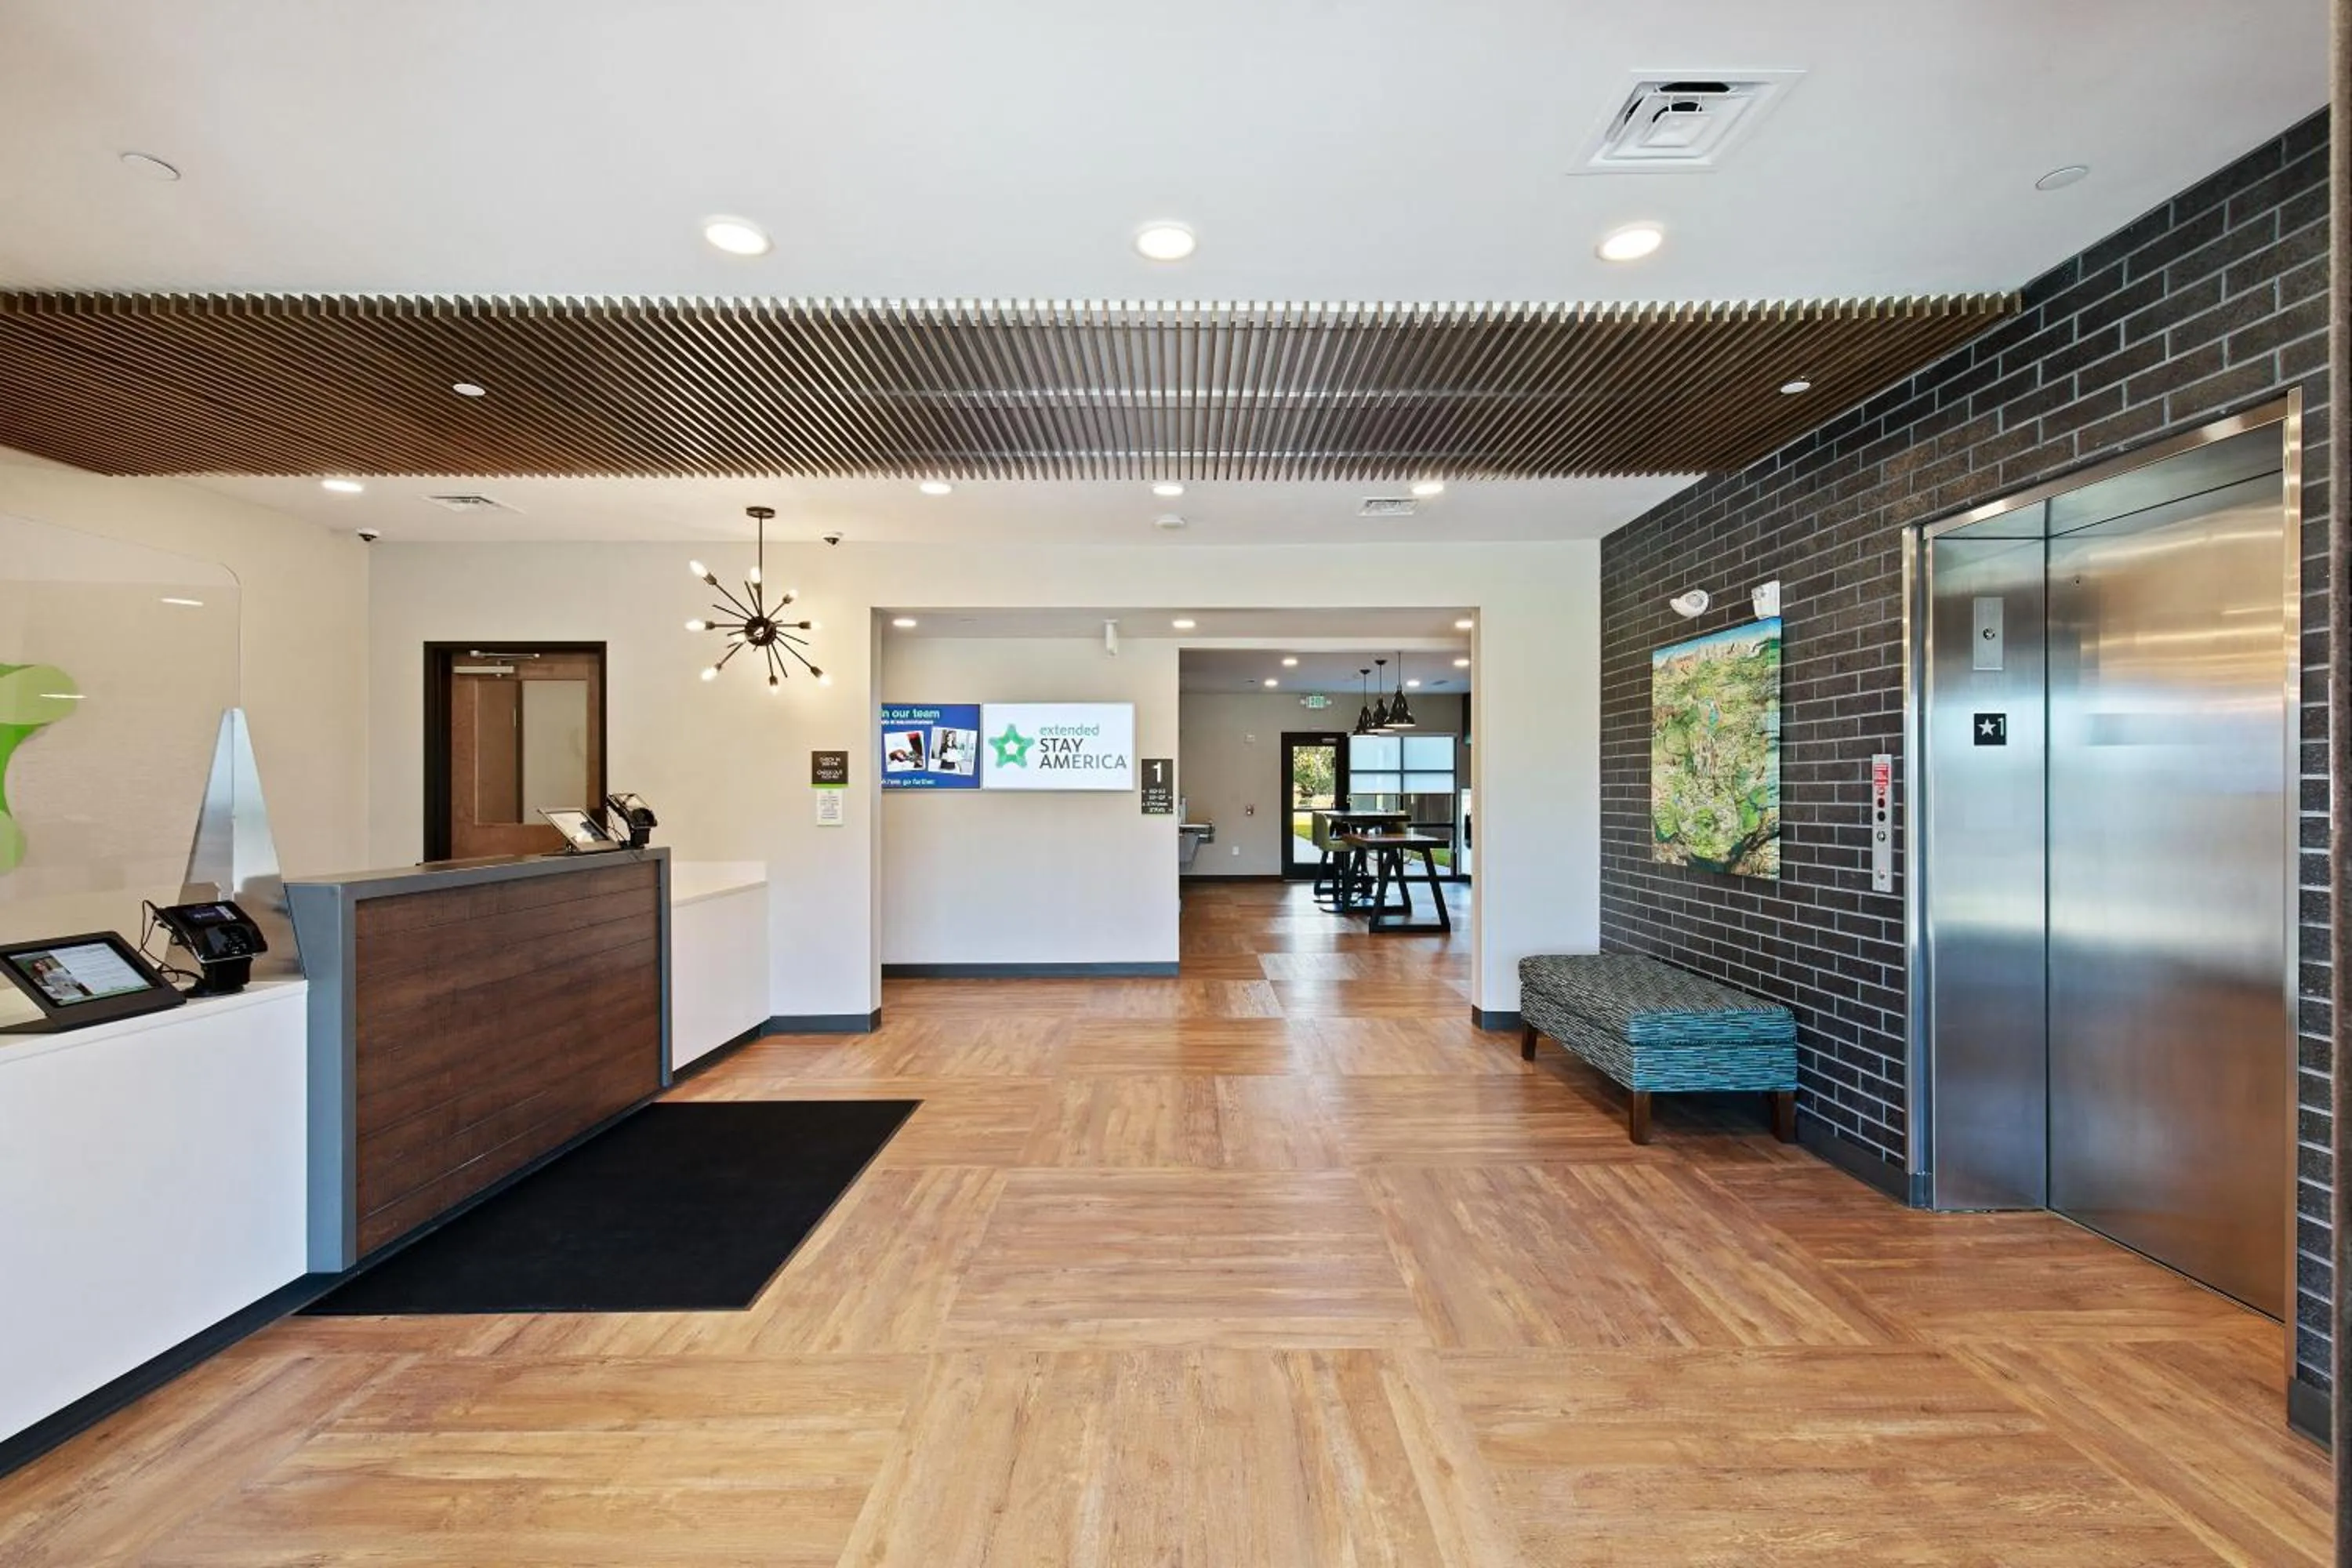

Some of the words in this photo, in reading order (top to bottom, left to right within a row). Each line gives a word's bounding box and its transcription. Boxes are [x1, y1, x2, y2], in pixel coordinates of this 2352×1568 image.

[891, 710, 909, 719] our
[913, 708, 940, 719] team
[1039, 723, 1100, 736] extended
[1997, 717, 2005, 737] 1
[1039, 738, 1084, 753] STAY
[1039, 753, 1127, 769] AMERICA
[1152, 761, 1162, 783] 1
